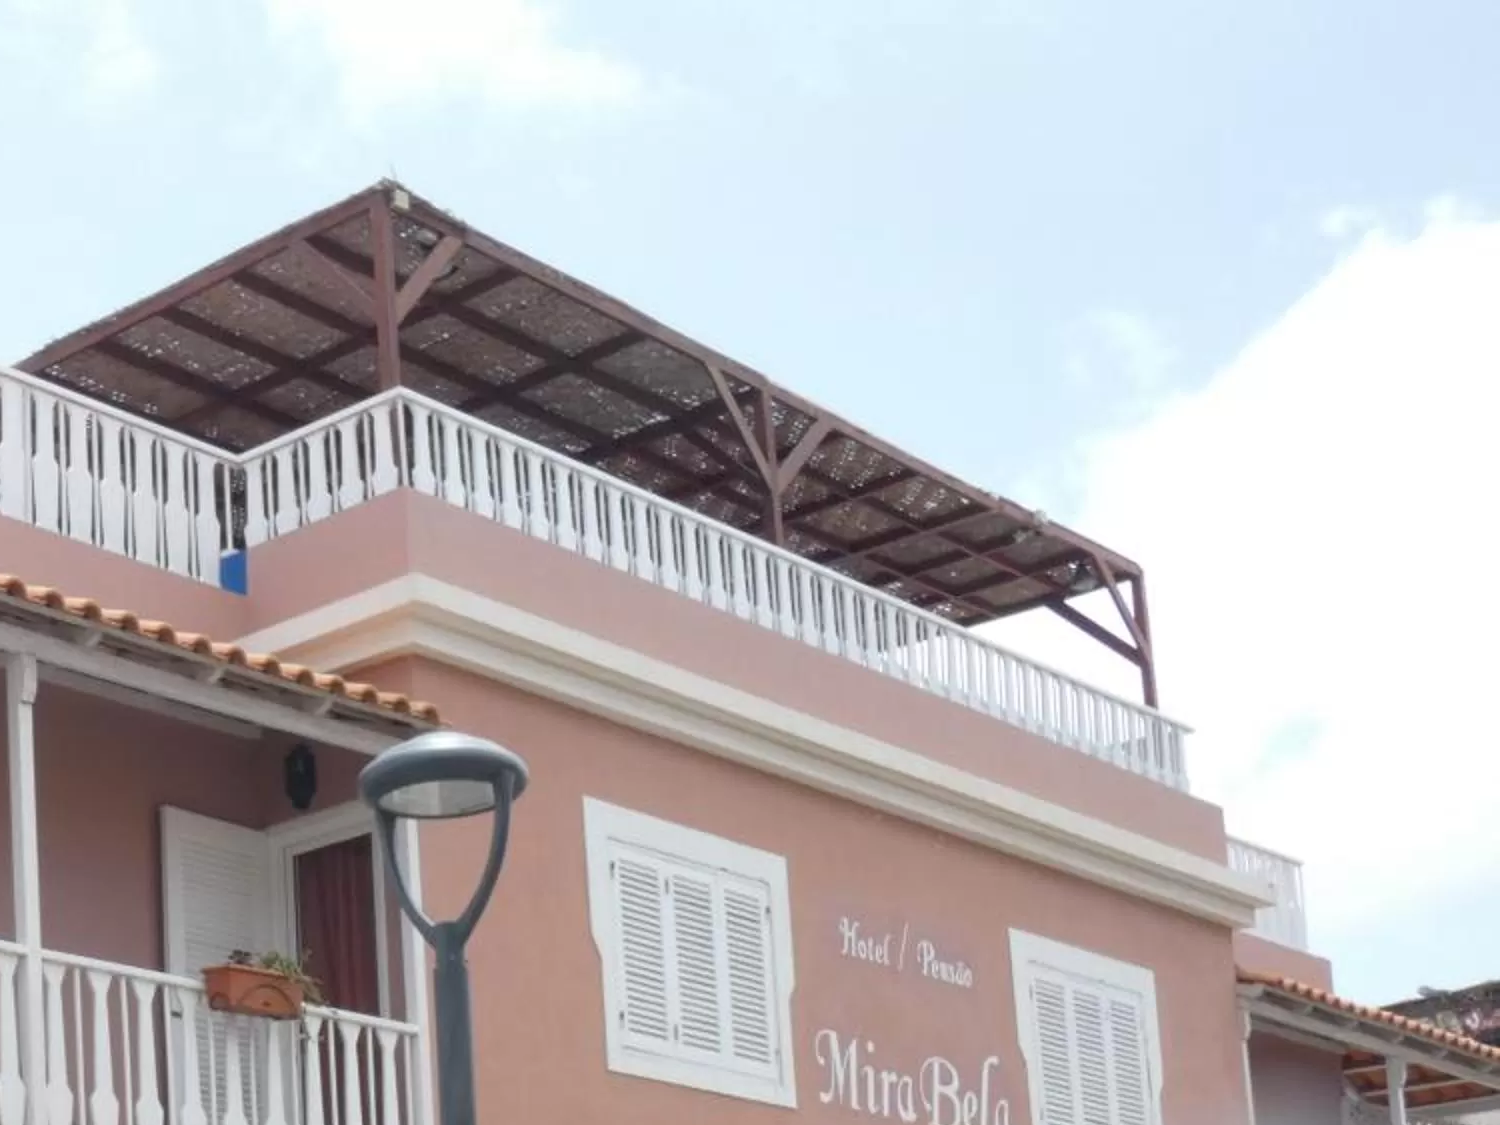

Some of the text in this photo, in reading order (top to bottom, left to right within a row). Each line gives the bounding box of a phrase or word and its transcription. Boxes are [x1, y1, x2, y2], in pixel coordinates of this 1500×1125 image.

[838, 917, 890, 966] Hotel
[916, 939, 974, 988] Pensão
[815, 1028, 917, 1124] Mira
